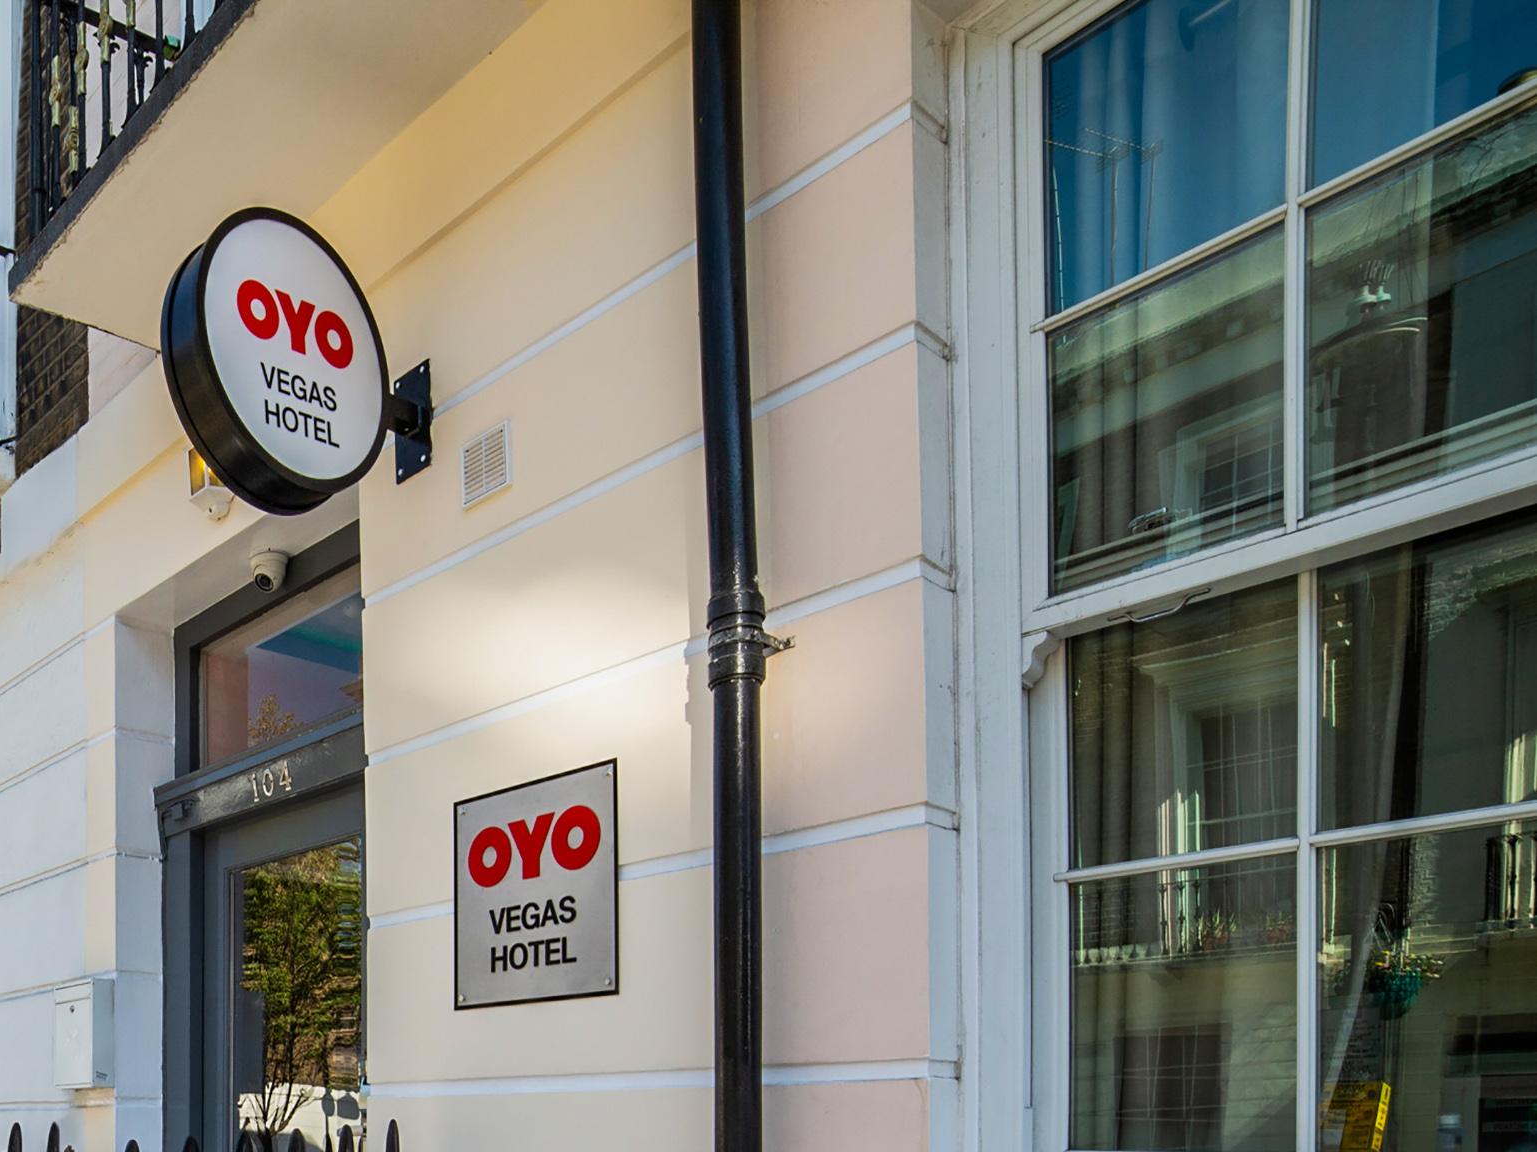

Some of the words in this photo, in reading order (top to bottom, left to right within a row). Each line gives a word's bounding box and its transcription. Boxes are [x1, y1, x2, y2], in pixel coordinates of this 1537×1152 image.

[237, 280, 354, 369] OYO
[260, 362, 337, 412] VEGAS
[264, 399, 340, 448] HOTEL
[247, 760, 292, 802] 104
[468, 805, 601, 888] OYO
[489, 895, 577, 935] VEGAS
[490, 936, 577, 973] HOTEL
